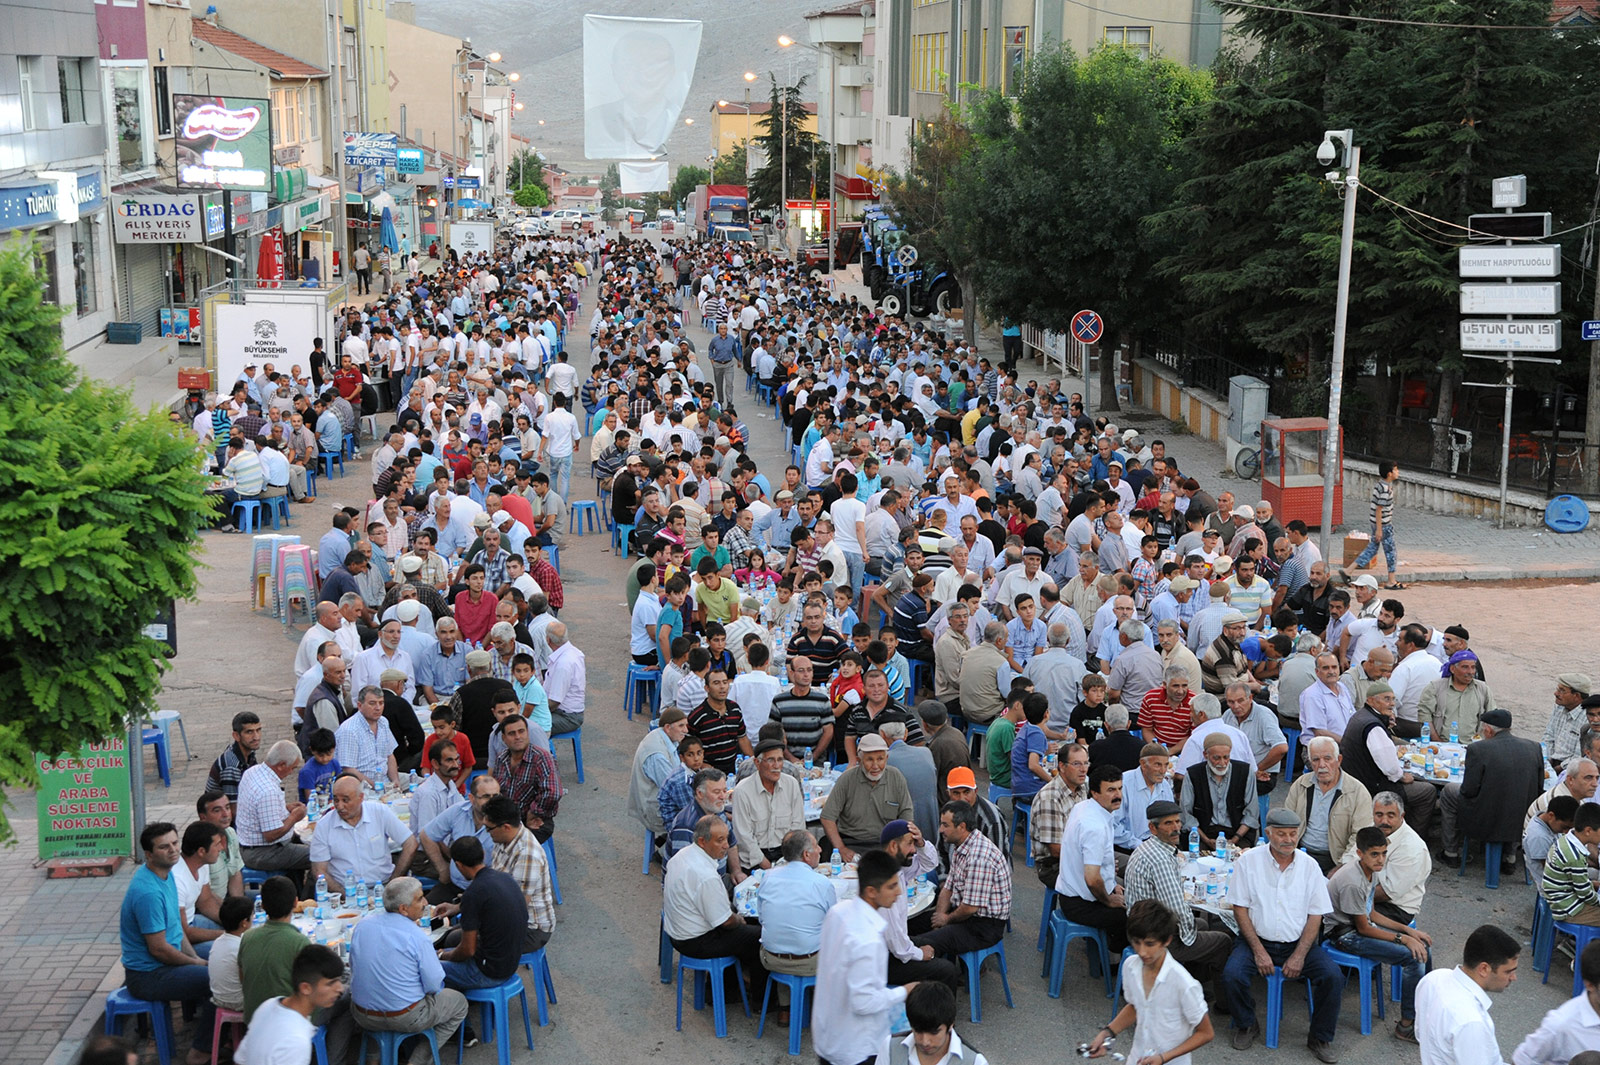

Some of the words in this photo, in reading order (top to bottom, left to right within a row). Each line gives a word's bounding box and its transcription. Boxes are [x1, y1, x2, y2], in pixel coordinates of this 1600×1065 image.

[357, 140, 391, 149] PEPSI
[353, 155, 382, 166] TİCARET
[126, 200, 195, 217] ERDAĞ
[125, 221, 152, 230] ALIŞ
[156, 221, 191, 230] VERİŞ
[132, 232, 186, 240] MERKEZİ
[1462, 259, 1491, 267] MEHMET
[1493, 257, 1551, 267] HARPUTLUOĞLU
[73, 773, 93, 784] VE
[58, 787, 109, 800] ARABA
[48, 801, 120, 816] SÜSLEME
[52, 817, 117, 830] NOKTASI
